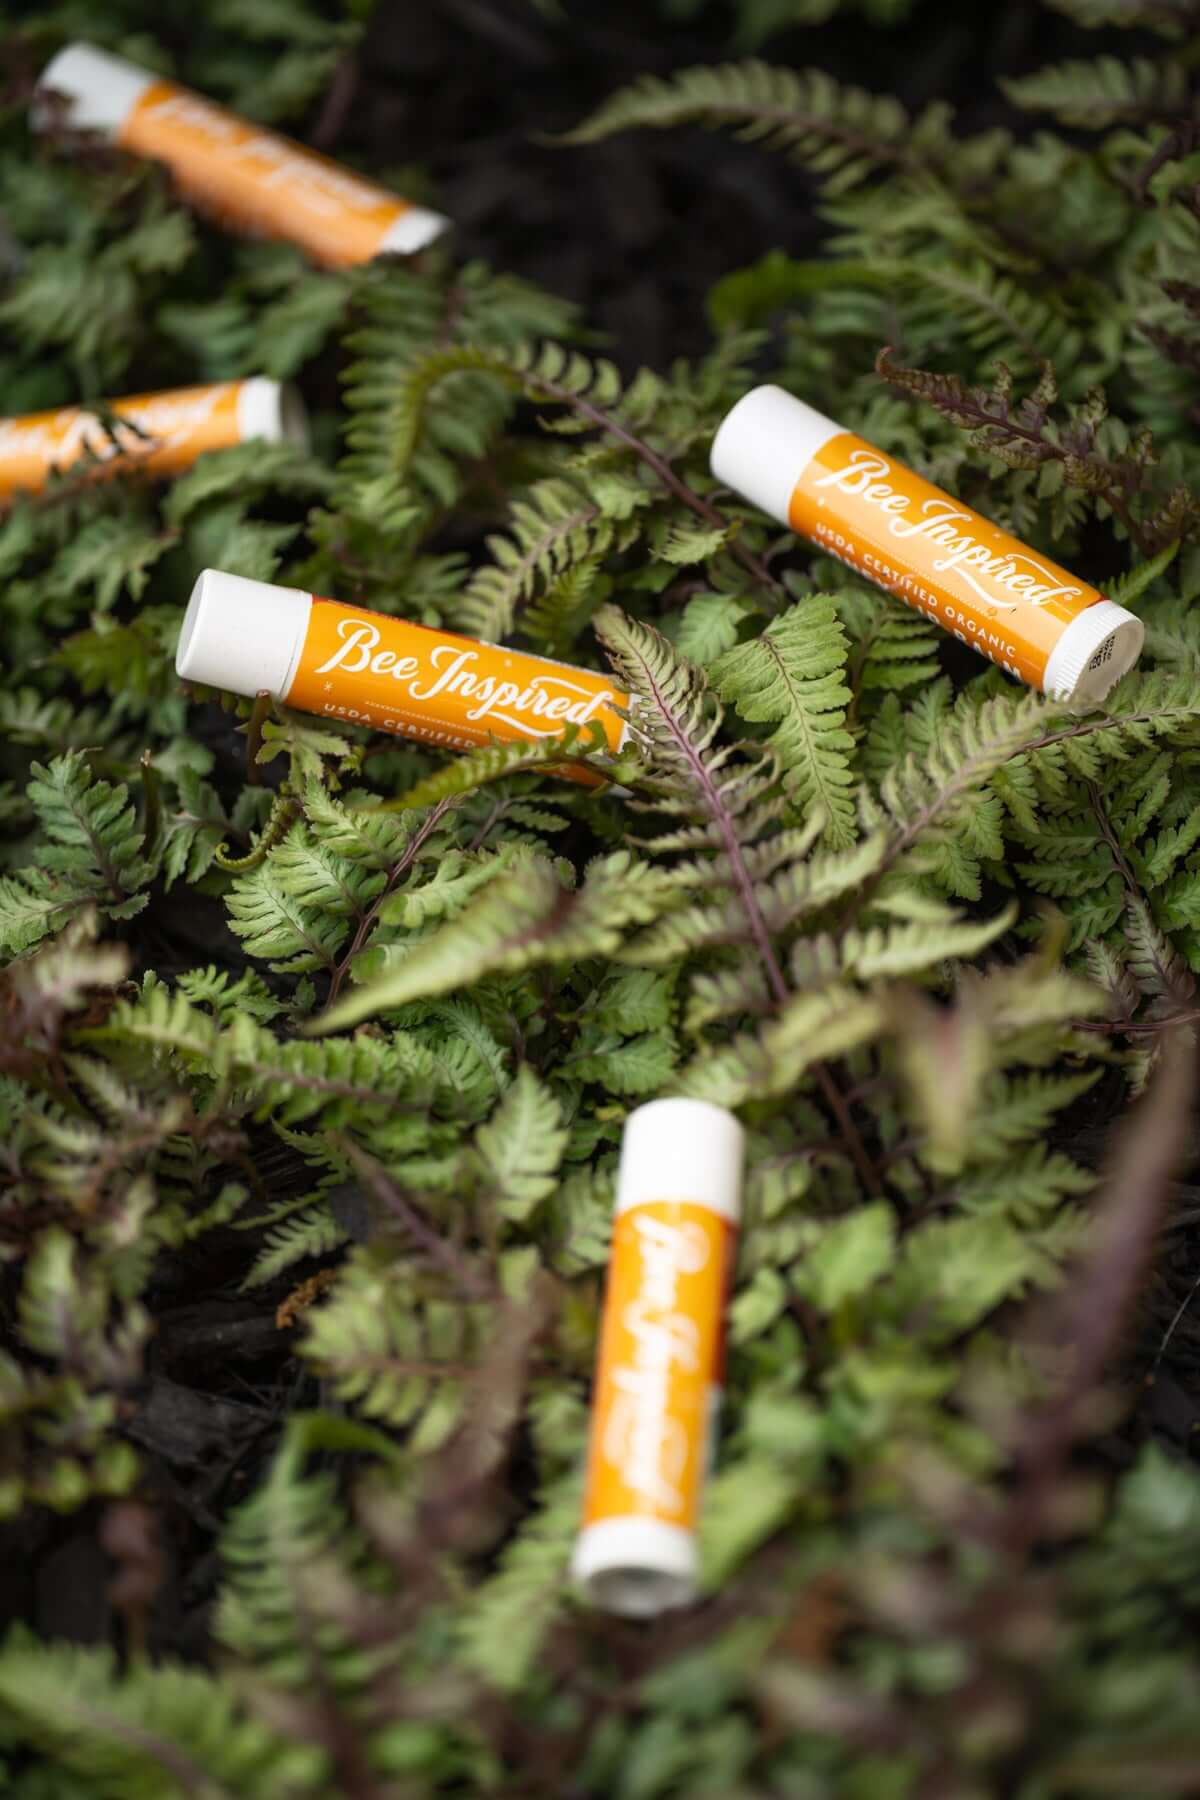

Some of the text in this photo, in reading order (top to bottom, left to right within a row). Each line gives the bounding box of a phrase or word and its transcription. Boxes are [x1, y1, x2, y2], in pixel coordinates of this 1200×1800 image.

[814, 450, 911, 513] Bee
[888, 499, 1083, 608] Inspired
[815, 521, 856, 555] USDA
[863, 553, 938, 607] CERTIFIED
[944, 605, 1017, 657] ORGANIC
[315, 618, 420, 680] Bee
[408, 645, 614, 737] Inspired
[323, 702, 372, 723] USDA
[382, 718, 477, 749] CERTIFIED
